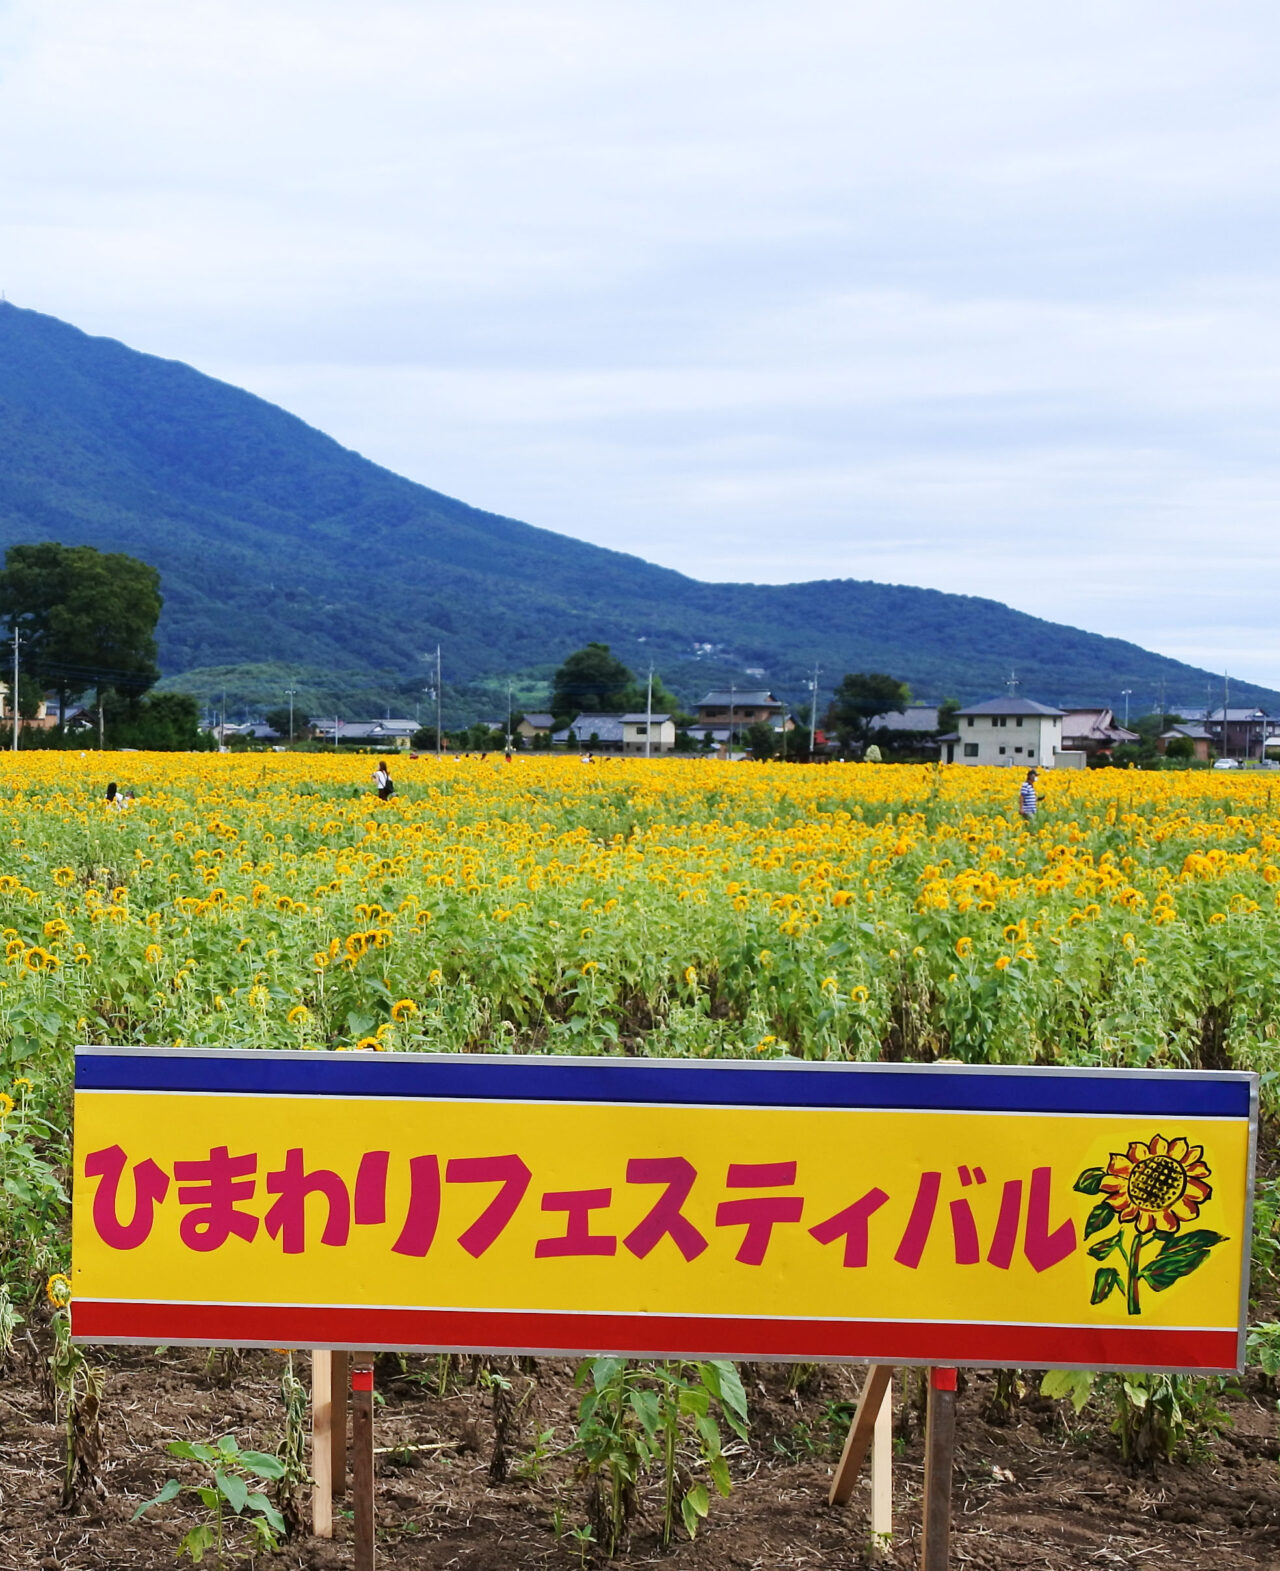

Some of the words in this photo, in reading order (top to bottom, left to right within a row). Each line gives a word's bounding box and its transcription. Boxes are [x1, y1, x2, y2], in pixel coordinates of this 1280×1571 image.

[85, 1145, 1077, 1271] ひまわりフェスティバル
